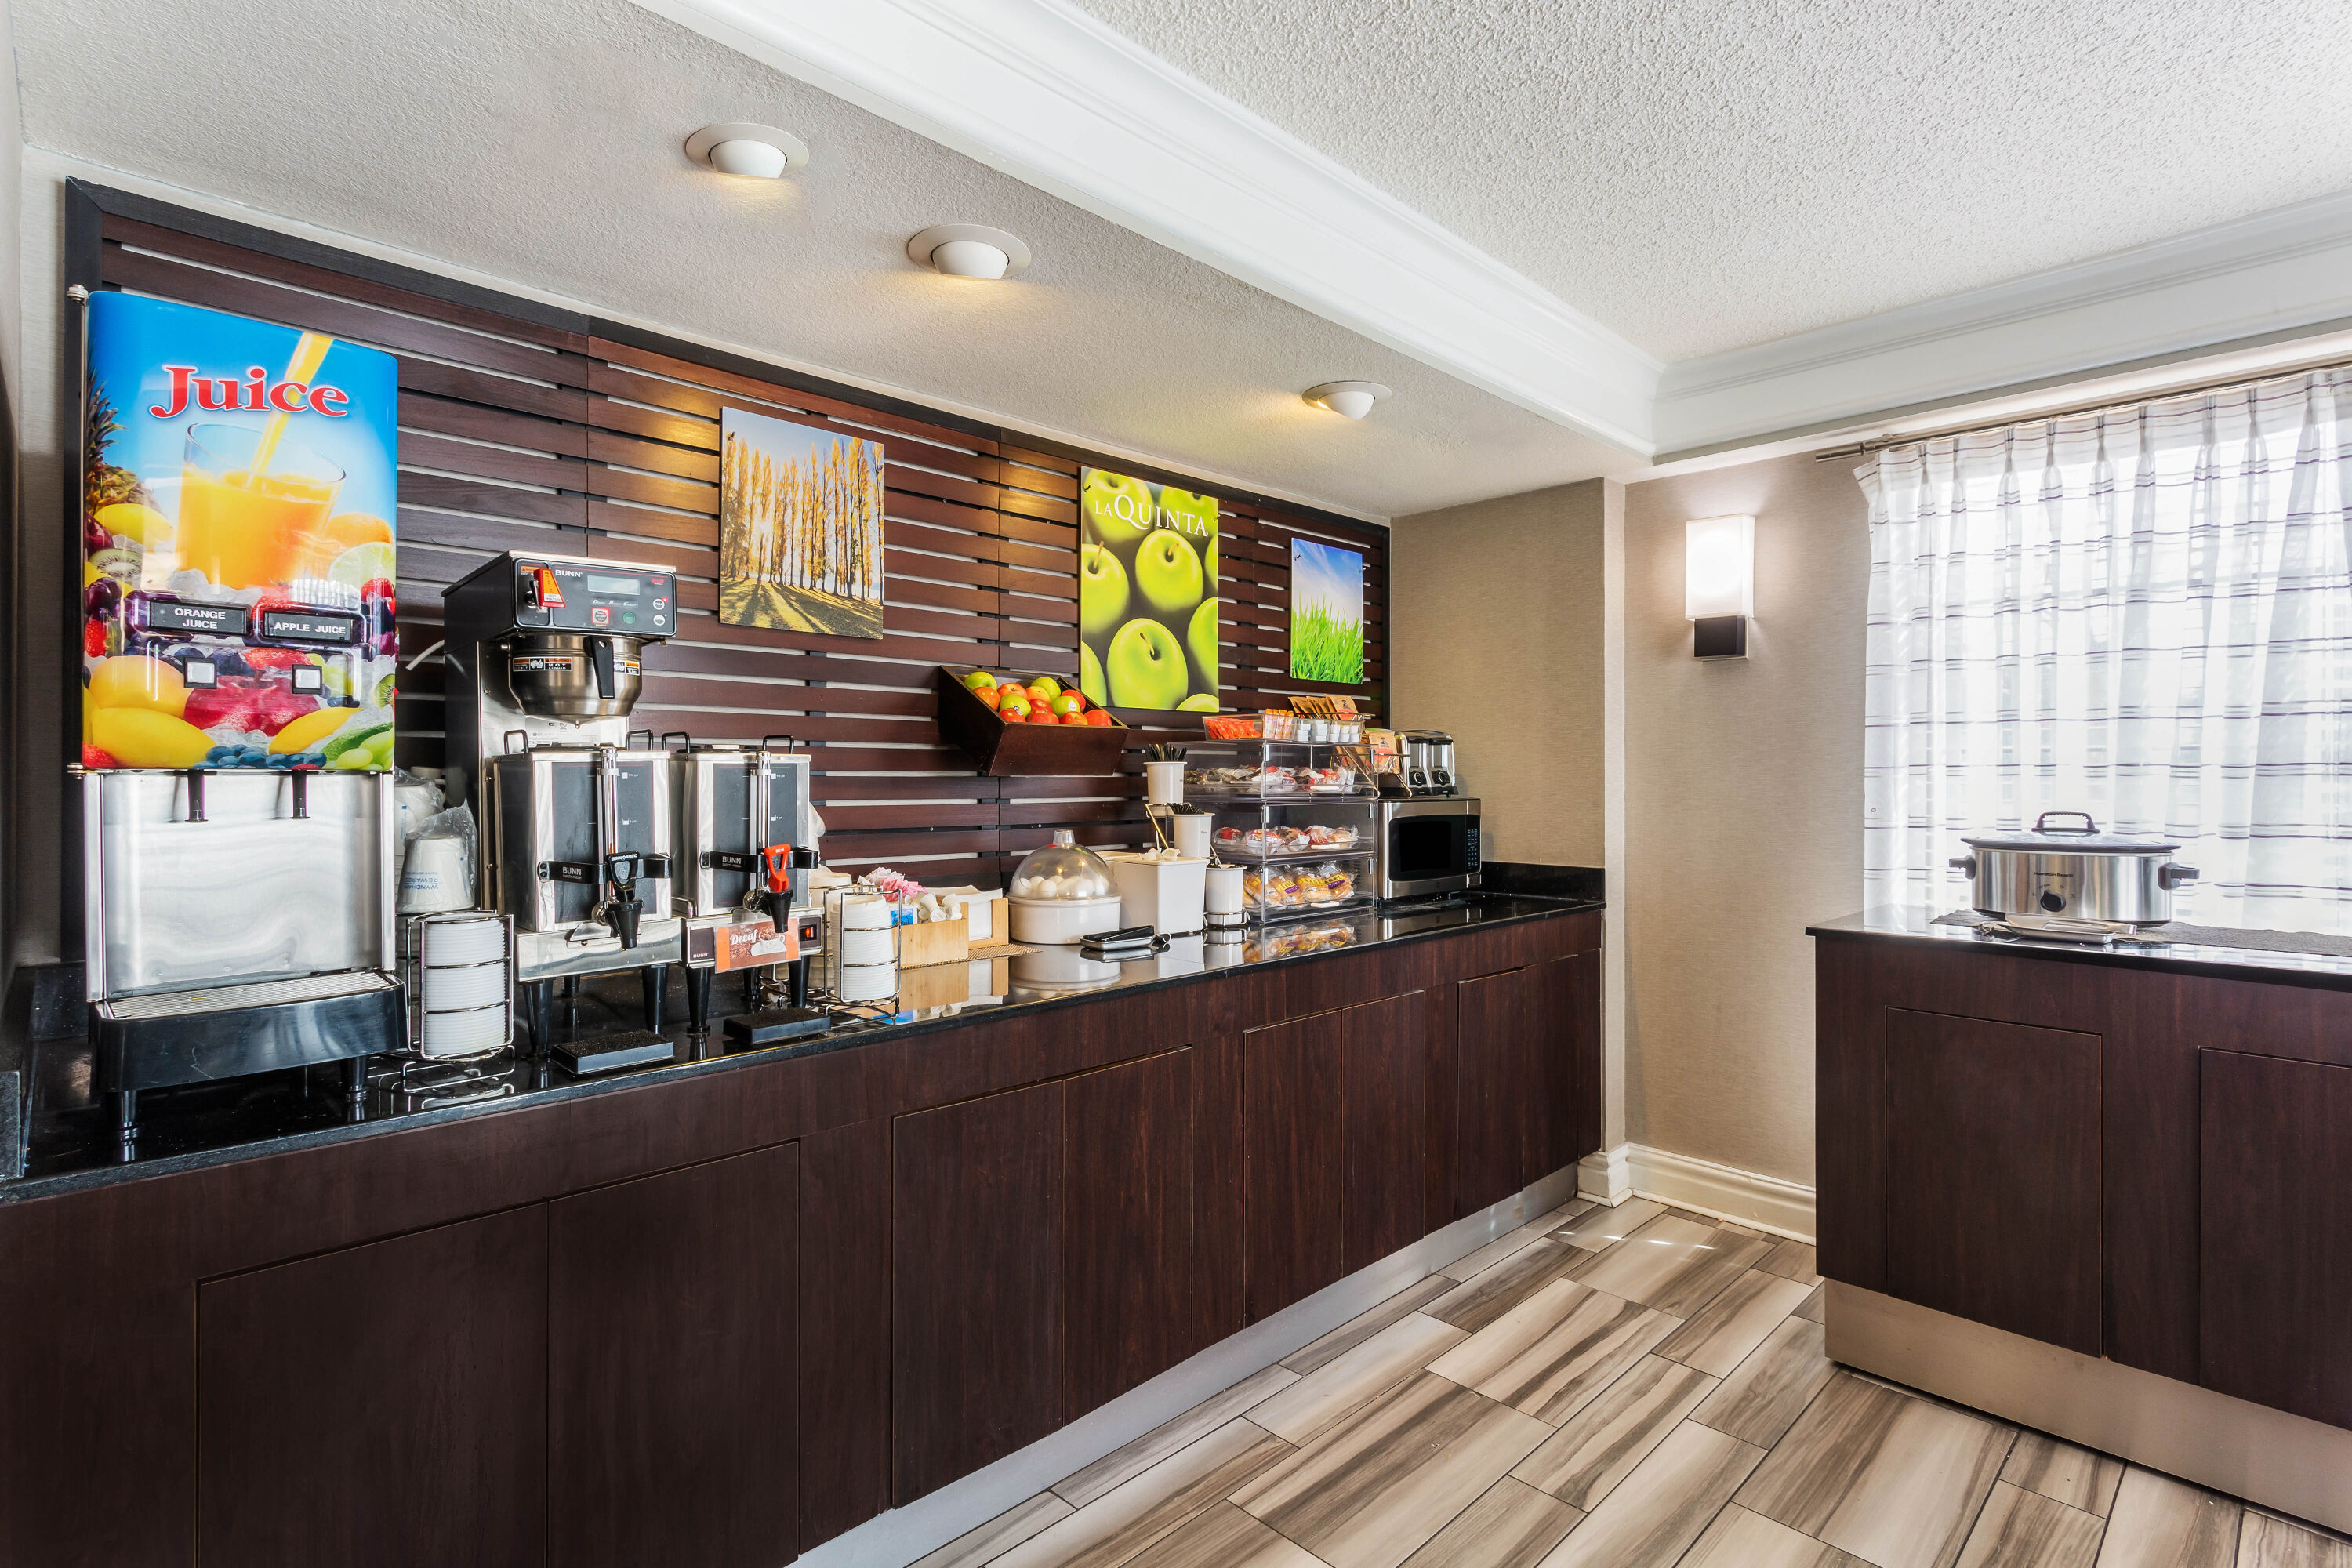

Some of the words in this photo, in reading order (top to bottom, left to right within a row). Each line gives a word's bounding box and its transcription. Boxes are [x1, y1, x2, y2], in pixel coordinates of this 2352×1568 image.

[149, 365, 349, 418] Juice
[1095, 500, 1112, 517] LA
[1114, 494, 1208, 537] QUINTA
[555, 569, 581, 578] BUNN
[174, 608, 226, 619] ORANGE
[182, 619, 218, 630] JUICE
[274, 622, 310, 632] APPLE
[314, 625, 347, 634] JUICE
[722, 855, 742, 864] BUNN
[562, 866, 582, 876] BUNN
[729, 928, 758, 946] Decaf
